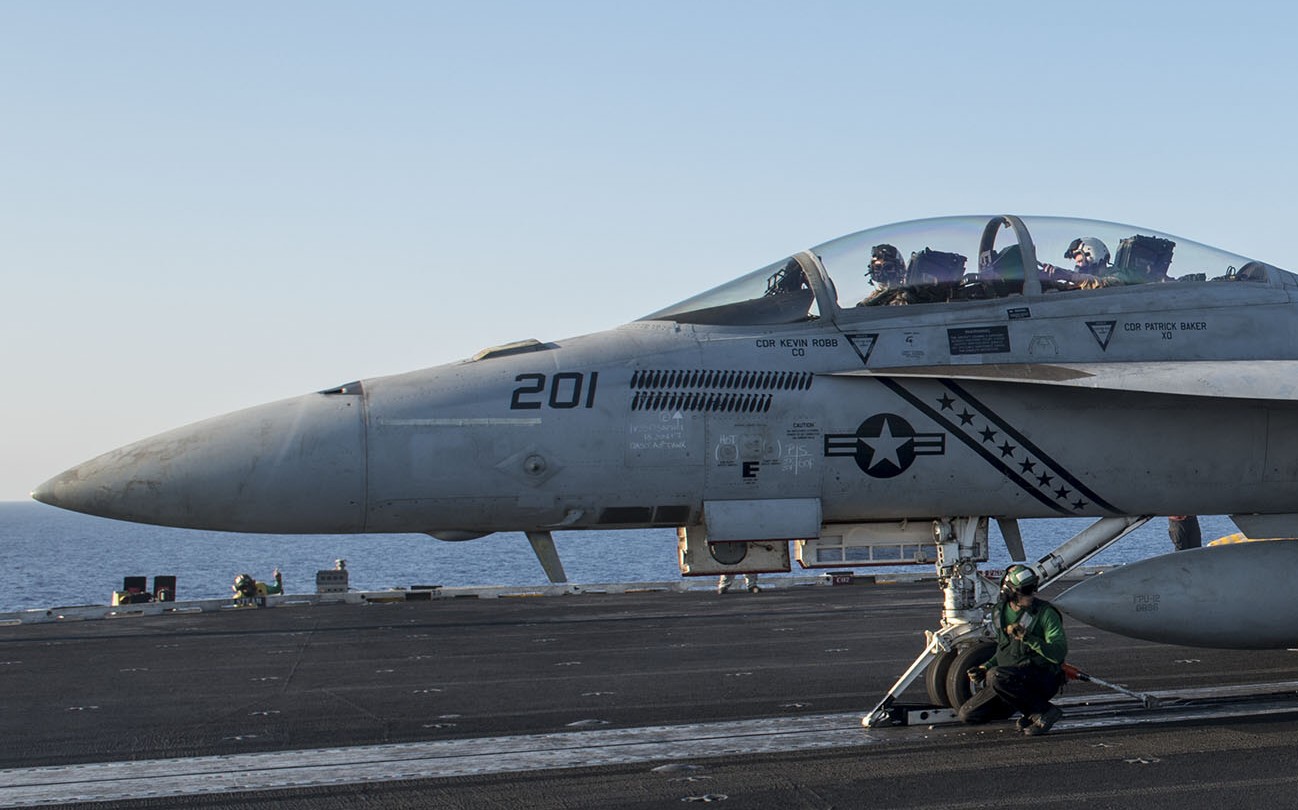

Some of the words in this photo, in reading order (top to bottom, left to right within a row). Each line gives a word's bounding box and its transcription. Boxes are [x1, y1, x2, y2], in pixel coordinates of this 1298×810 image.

[1124, 322, 1142, 331] CDR
[1145, 322, 1177, 331] PATRICK
[1180, 321, 1207, 331] BAKER
[1161, 331, 1173, 340] XO
[755, 339, 776, 348] CDR
[780, 338, 808, 347] KEVIN
[812, 338, 839, 347] ROBB
[791, 347, 805, 357] CO
[510, 371, 599, 410] 201
